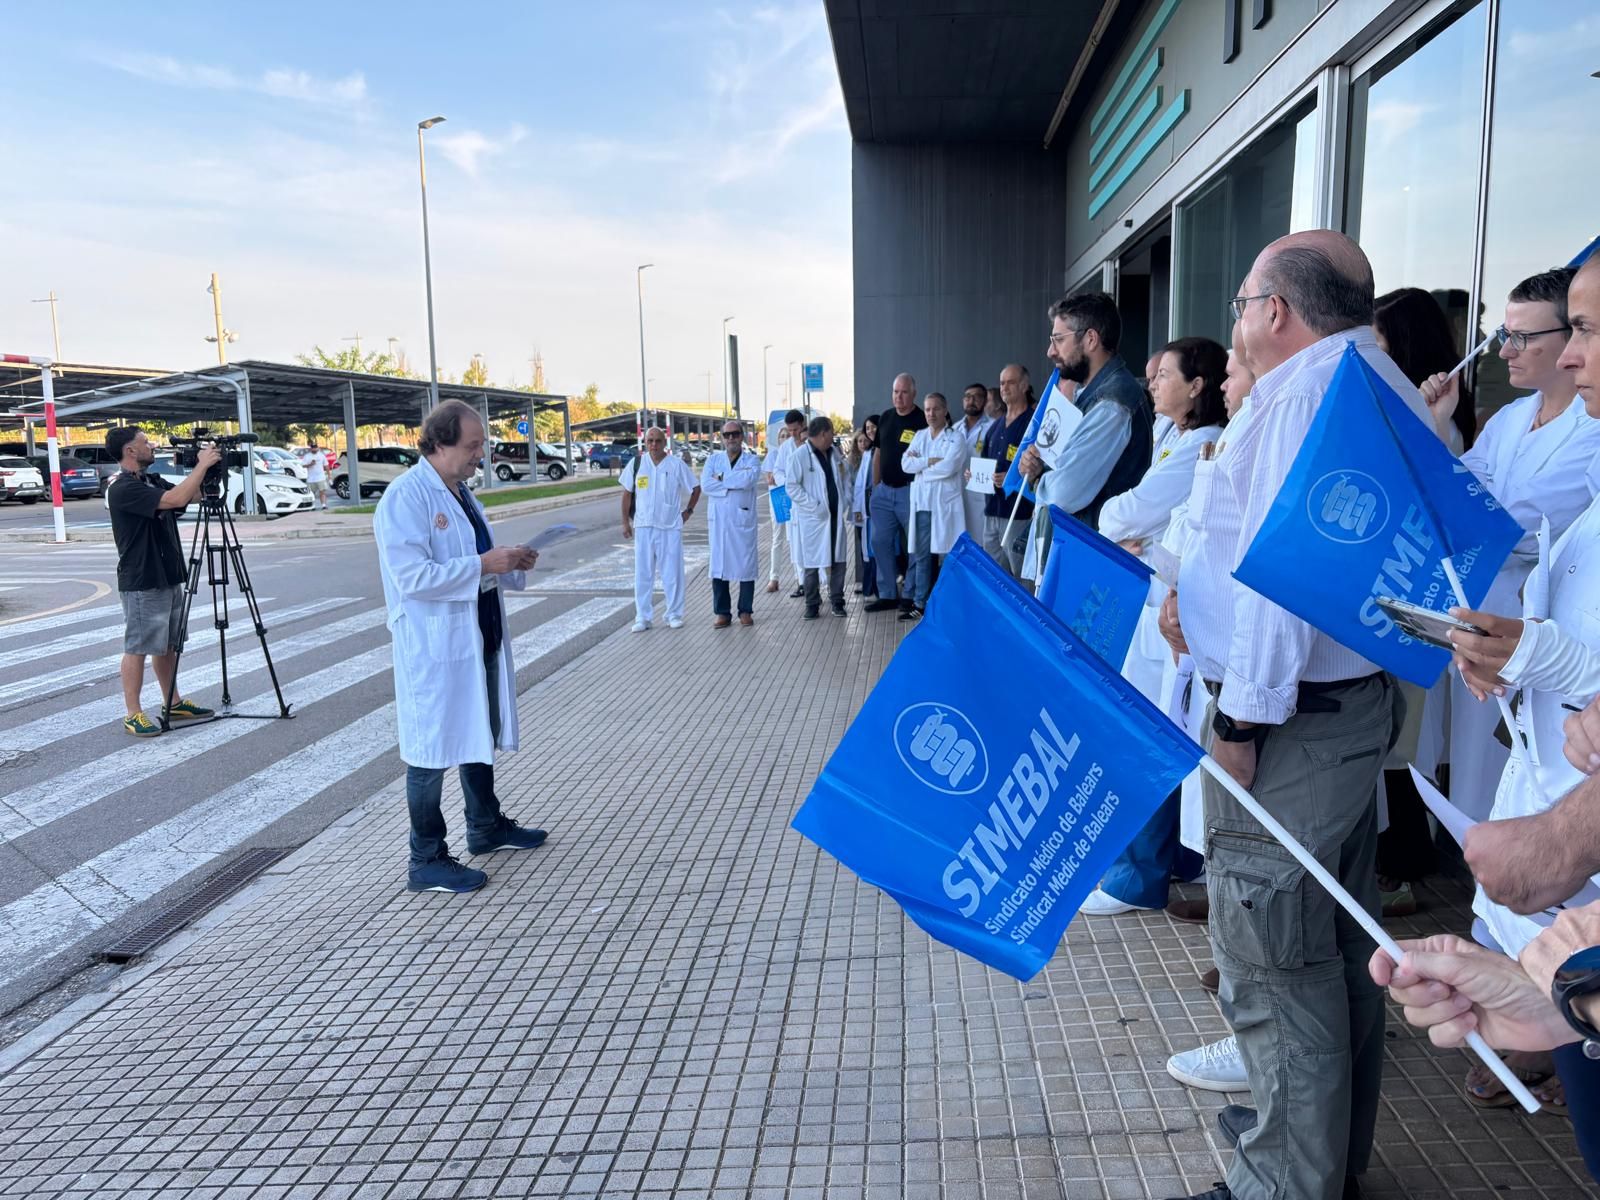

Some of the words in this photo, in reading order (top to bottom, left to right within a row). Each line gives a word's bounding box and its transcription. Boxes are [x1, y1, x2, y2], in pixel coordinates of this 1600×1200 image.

[942, 706, 1081, 919] SIMEBAL
[1082, 790, 1120, 843] Balears
[984, 872, 1038, 935] Sindicato
[1028, 830, 1065, 877] Médico
[1058, 810, 1077, 833] de
[1068, 762, 1104, 815] Balears
[1050, 853, 1081, 897] Mèdic
[1074, 837, 1092, 859] de
[1010, 891, 1057, 946] Sindicat
